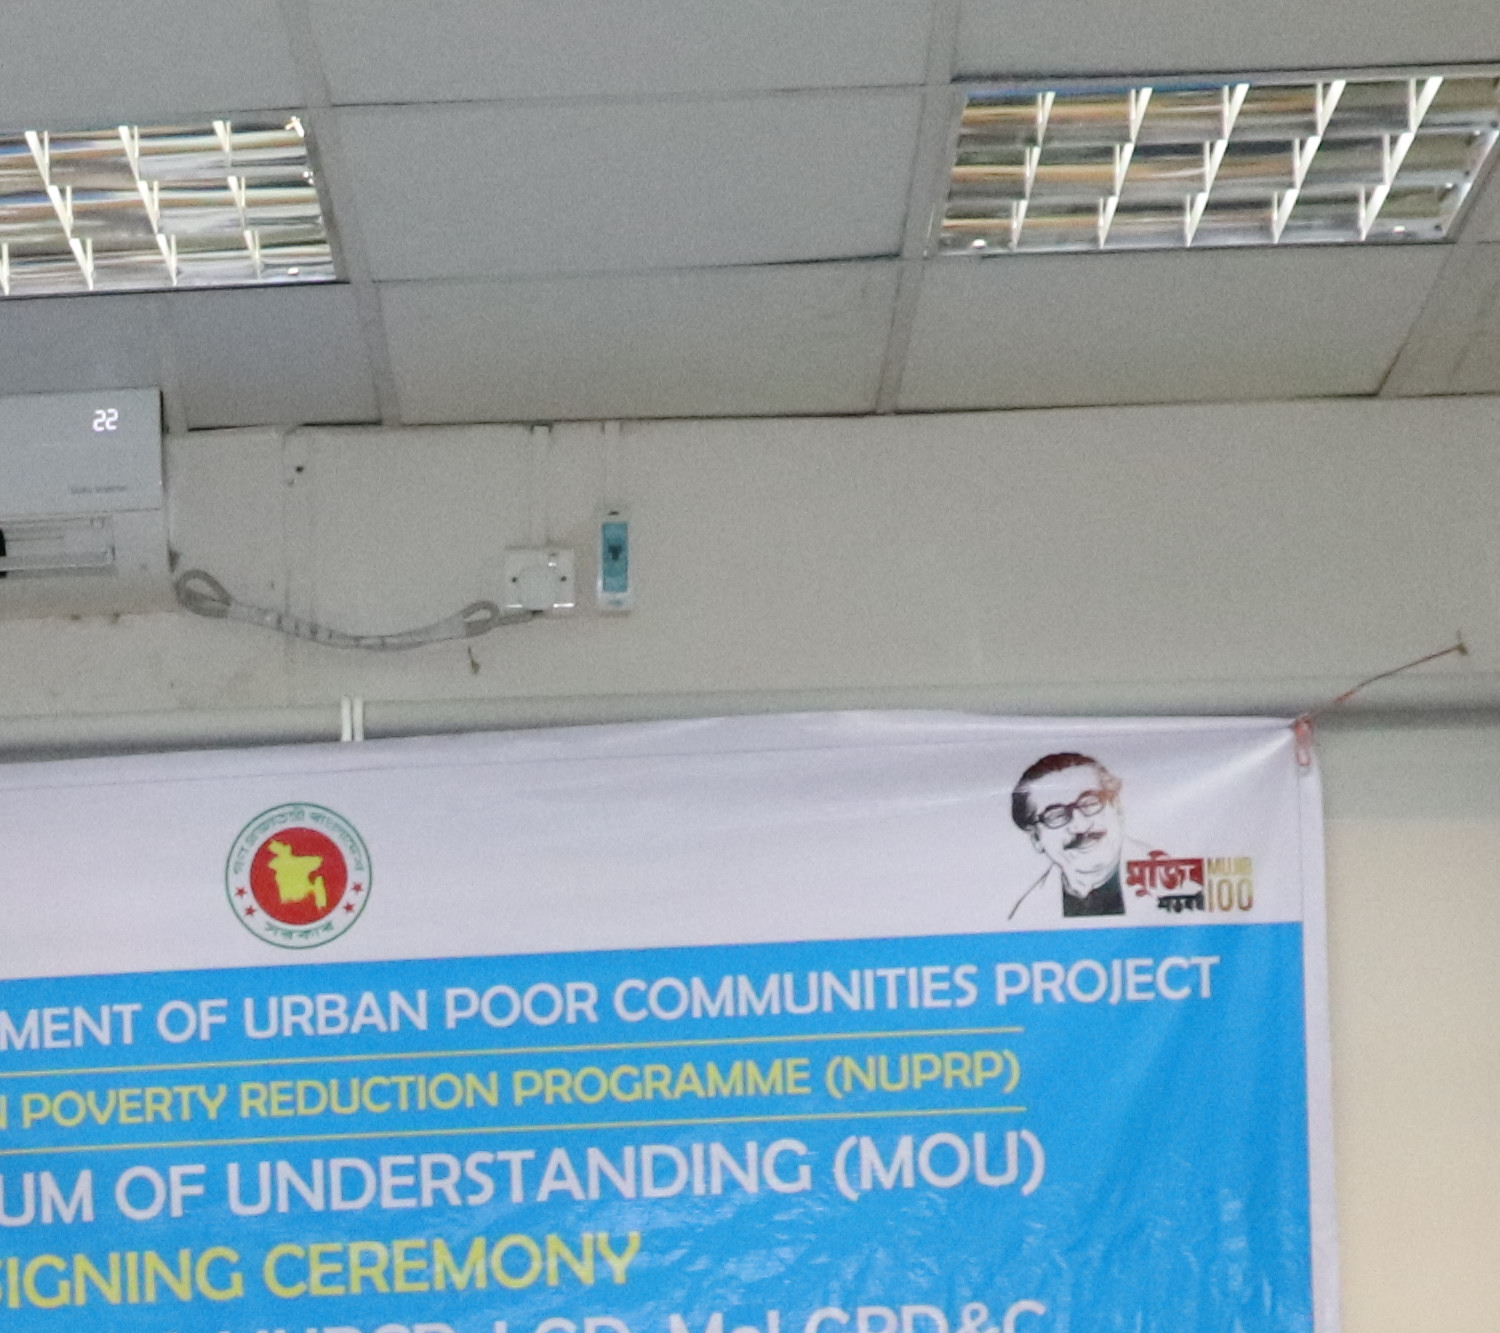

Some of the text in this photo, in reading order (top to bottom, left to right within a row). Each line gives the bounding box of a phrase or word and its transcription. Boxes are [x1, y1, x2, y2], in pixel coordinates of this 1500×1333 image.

[92, 408, 119, 432] 22
[156, 999, 228, 1044] OF
[244, 990, 428, 1039] URBAN
[445, 982, 599, 1029] POOR
[613, 965, 979, 1022] COMMUNITIES
[995, 955, 1221, 1006] PROJECT
[21, 1084, 228, 1129] POVERTY
[239, 1071, 499, 1119] REDUCTION
[512, 1058, 812, 1106] PROGRAMME
[824, 1049, 1022, 1100] (NUPRP)
[114, 1163, 207, 1222] OF
[226, 1139, 813, 1217] UNDERSTANDING
[832, 1128, 1047, 1202] (MOU)
[262, 1231, 642, 1299] CEREMONY
